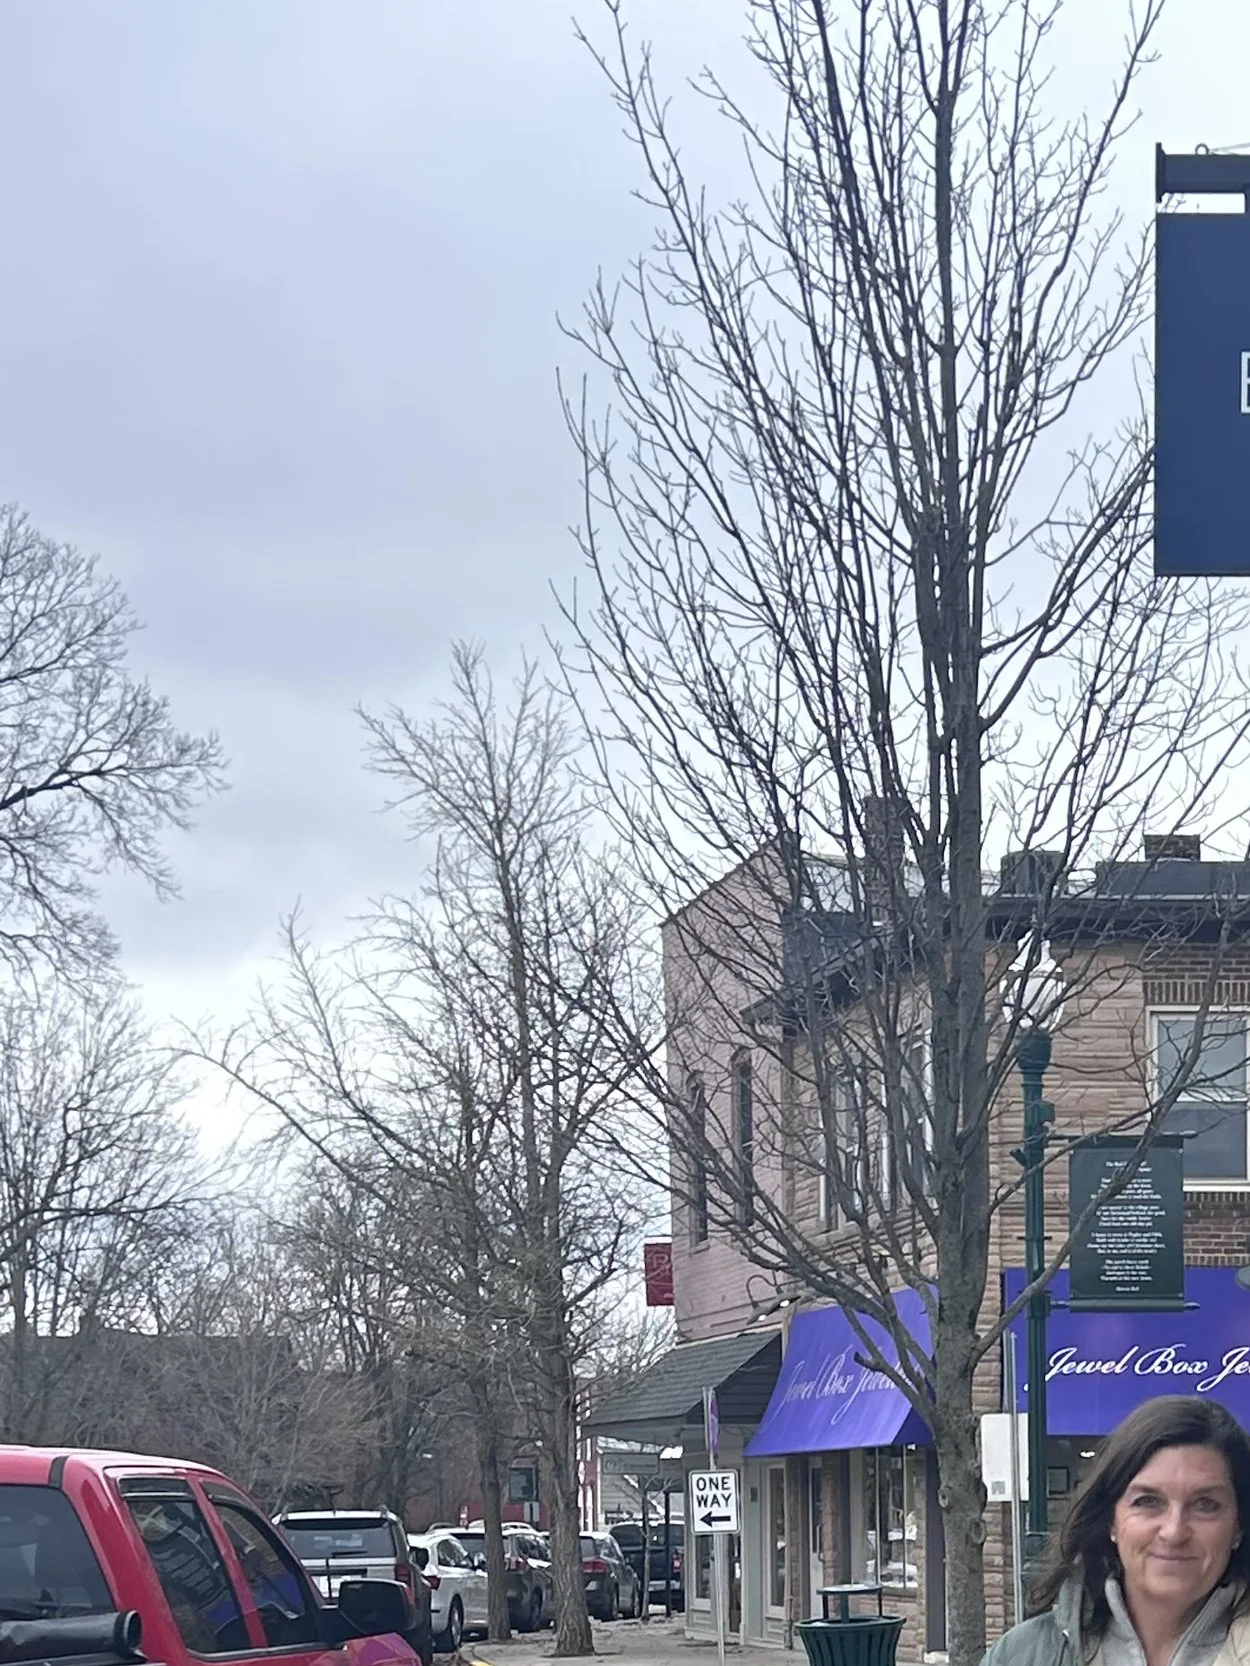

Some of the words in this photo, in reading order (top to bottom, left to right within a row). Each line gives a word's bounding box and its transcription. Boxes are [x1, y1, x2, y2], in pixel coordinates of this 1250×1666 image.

[1024, 1345, 1139, 1392] Jewel
[1134, 1343, 1209, 1376] Box
[764, 1352, 832, 1430] Jewel
[815, 1343, 853, 1400] Box
[695, 1475, 732, 1492] ONE
[695, 1492, 733, 1509] WAY
